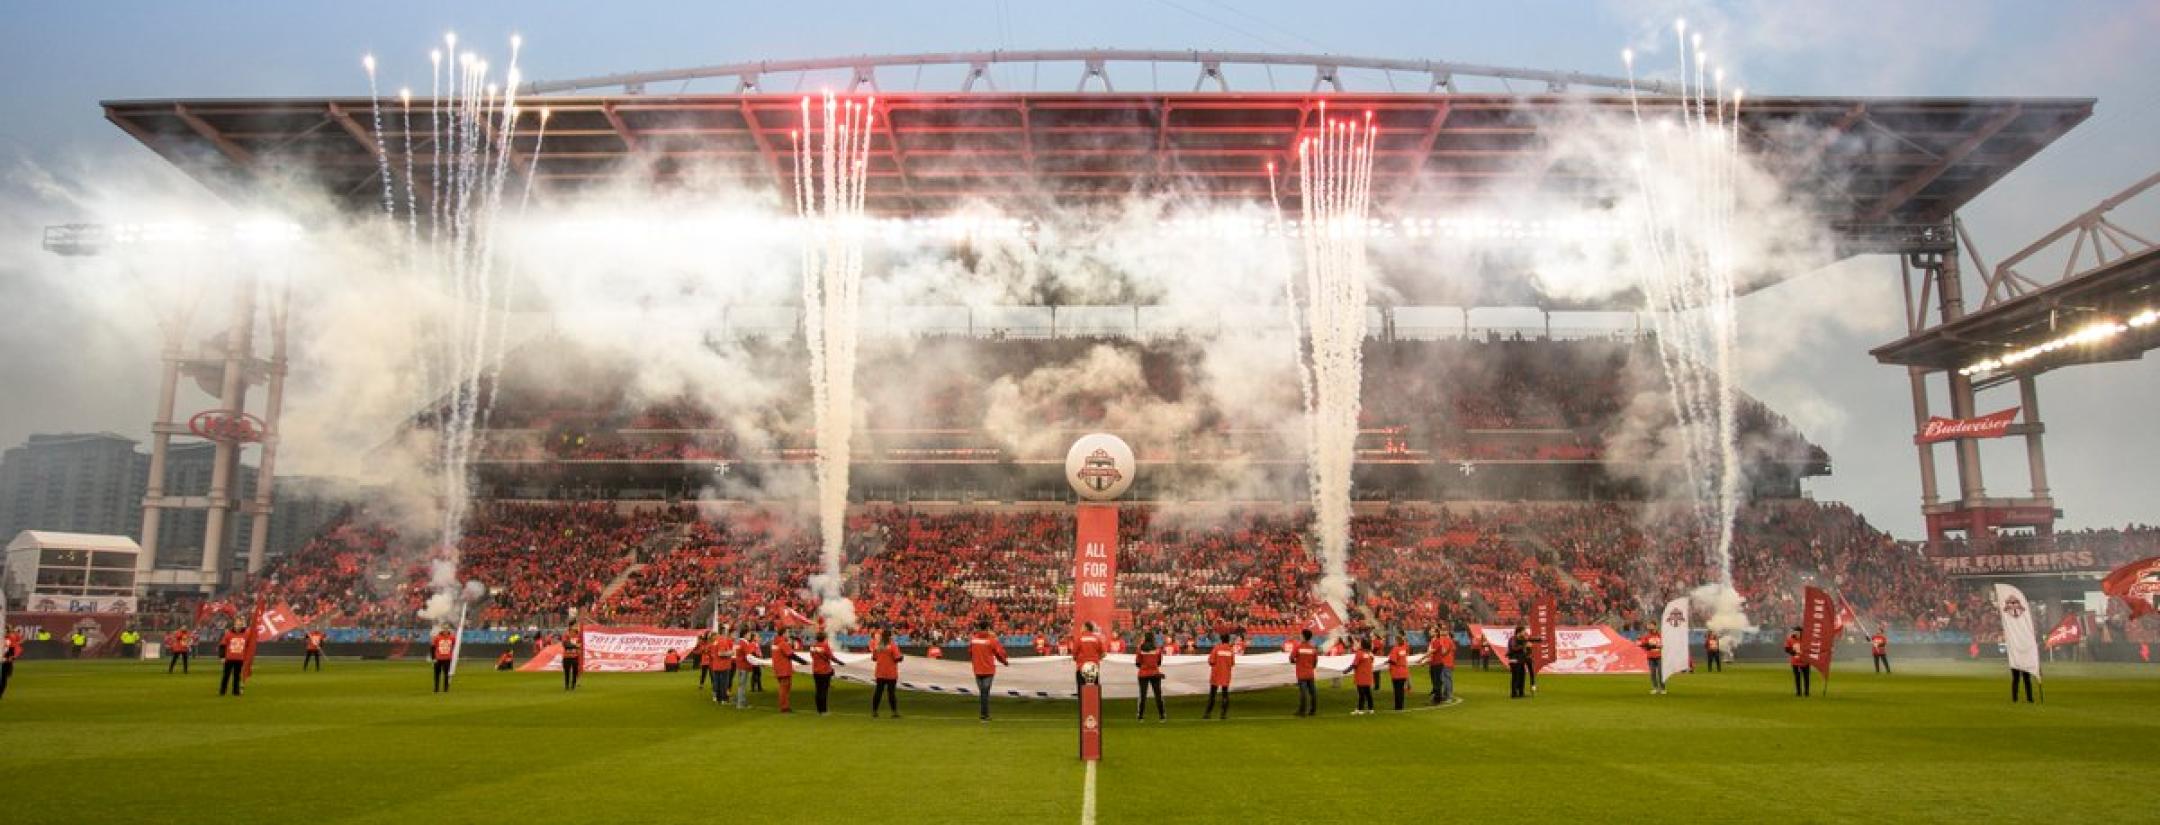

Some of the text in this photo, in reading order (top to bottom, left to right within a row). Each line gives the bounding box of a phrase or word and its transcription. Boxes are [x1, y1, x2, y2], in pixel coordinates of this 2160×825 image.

[1924, 417, 2010, 437] Budweiser
[1085, 542, 1107, 558] ALL
[1975, 550, 2095, 569] FORTRESS
[1083, 562, 1107, 578] FOR
[1082, 582, 1107, 598] ONE
[1813, 599, 1825, 619] ONE
[1808, 641, 1821, 660] ALL
